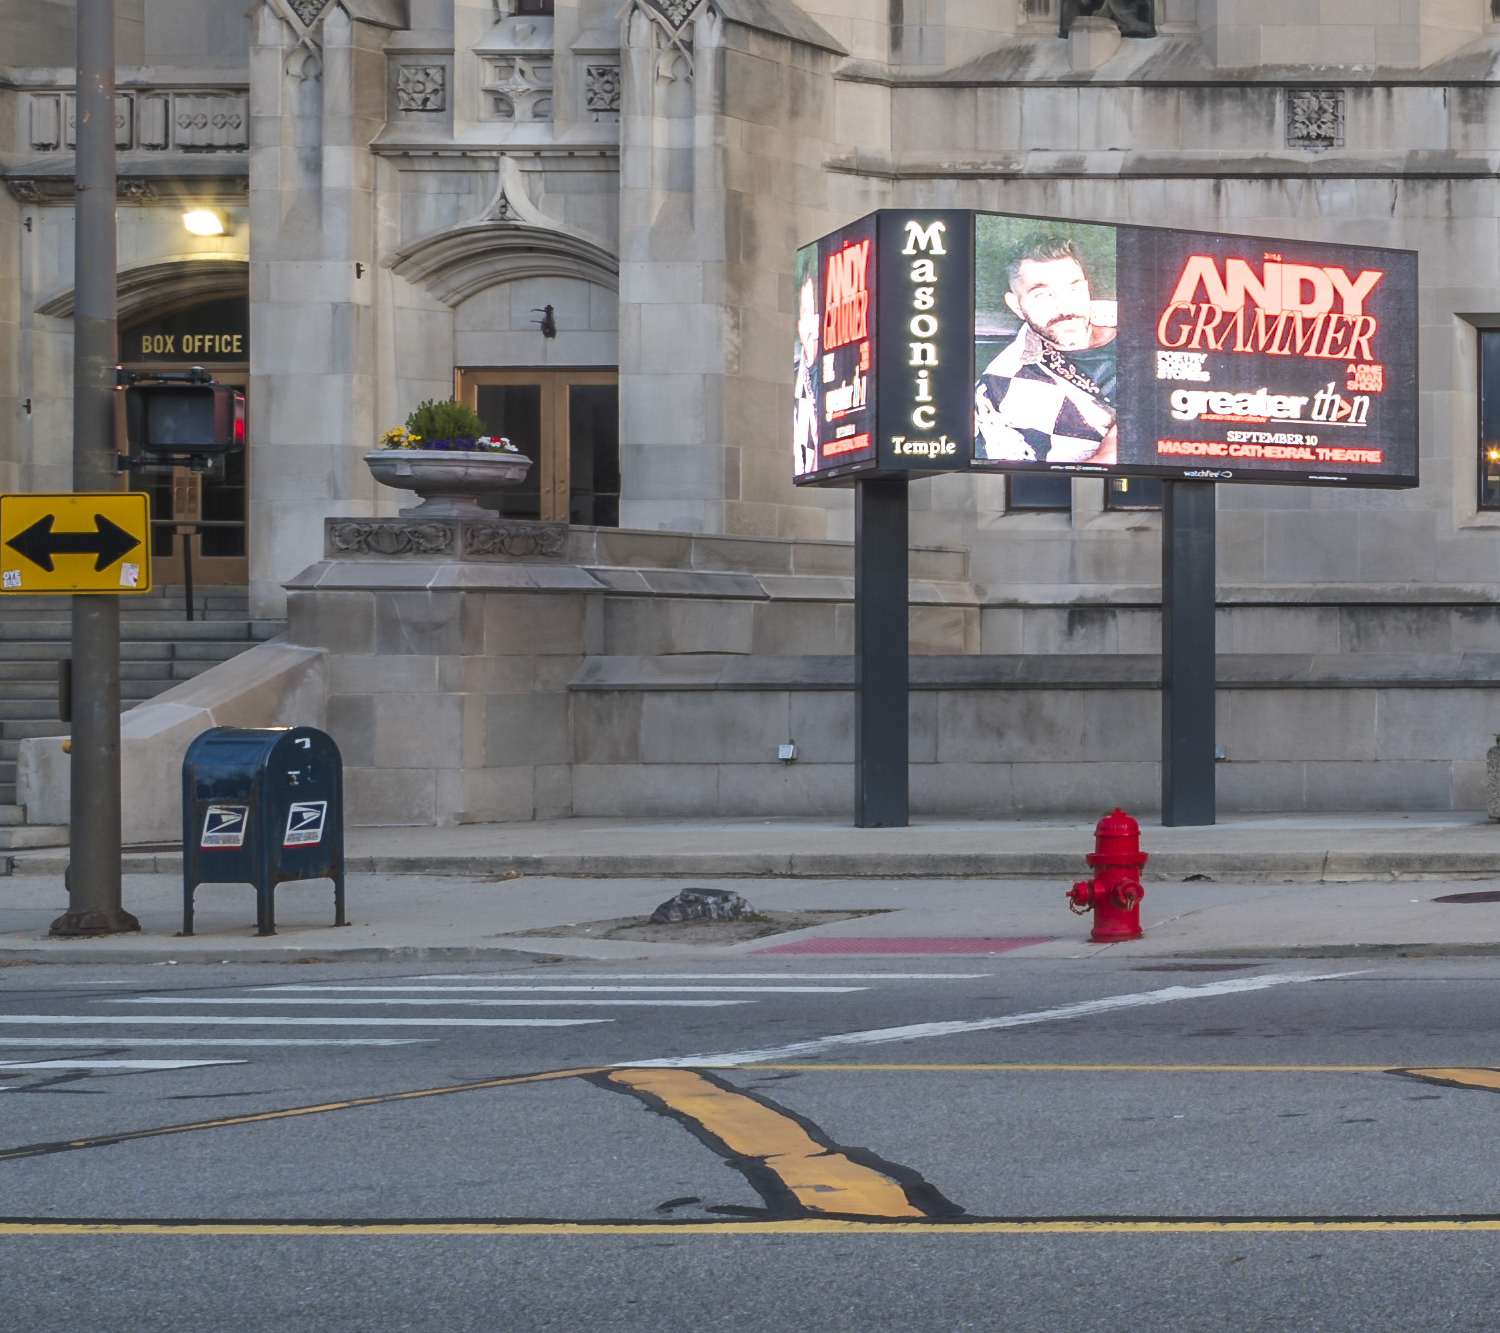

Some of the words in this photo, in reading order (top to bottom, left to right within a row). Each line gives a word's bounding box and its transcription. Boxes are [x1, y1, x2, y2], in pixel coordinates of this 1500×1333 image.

[826, 239, 869, 306] ANDY
[1170, 255, 1384, 318] ANDY
[901, 220, 947, 429] Masonic
[1157, 301, 1377, 360] GRAMMER
[142, 335, 175, 353] BOX
[182, 334, 243, 353] OFFICE
[1346, 363, 1356, 373] A
[1357, 364, 1383, 375] ONE
[1355, 373, 1383, 383] MAN
[1346, 380, 1383, 392] SHOW
[1171, 387, 1309, 421] greater
[892, 435, 956, 458] Temple
[1227, 431, 1304, 445] SEPTEMBER
[1305, 435, 1318, 446] 10
[1157, 441, 1227, 456] MASONIC
[1229, 444, 1316, 461] CATHEDRAL
[1315, 448, 1382, 463] THEATRE
[3, 570, 20, 580] OYE
